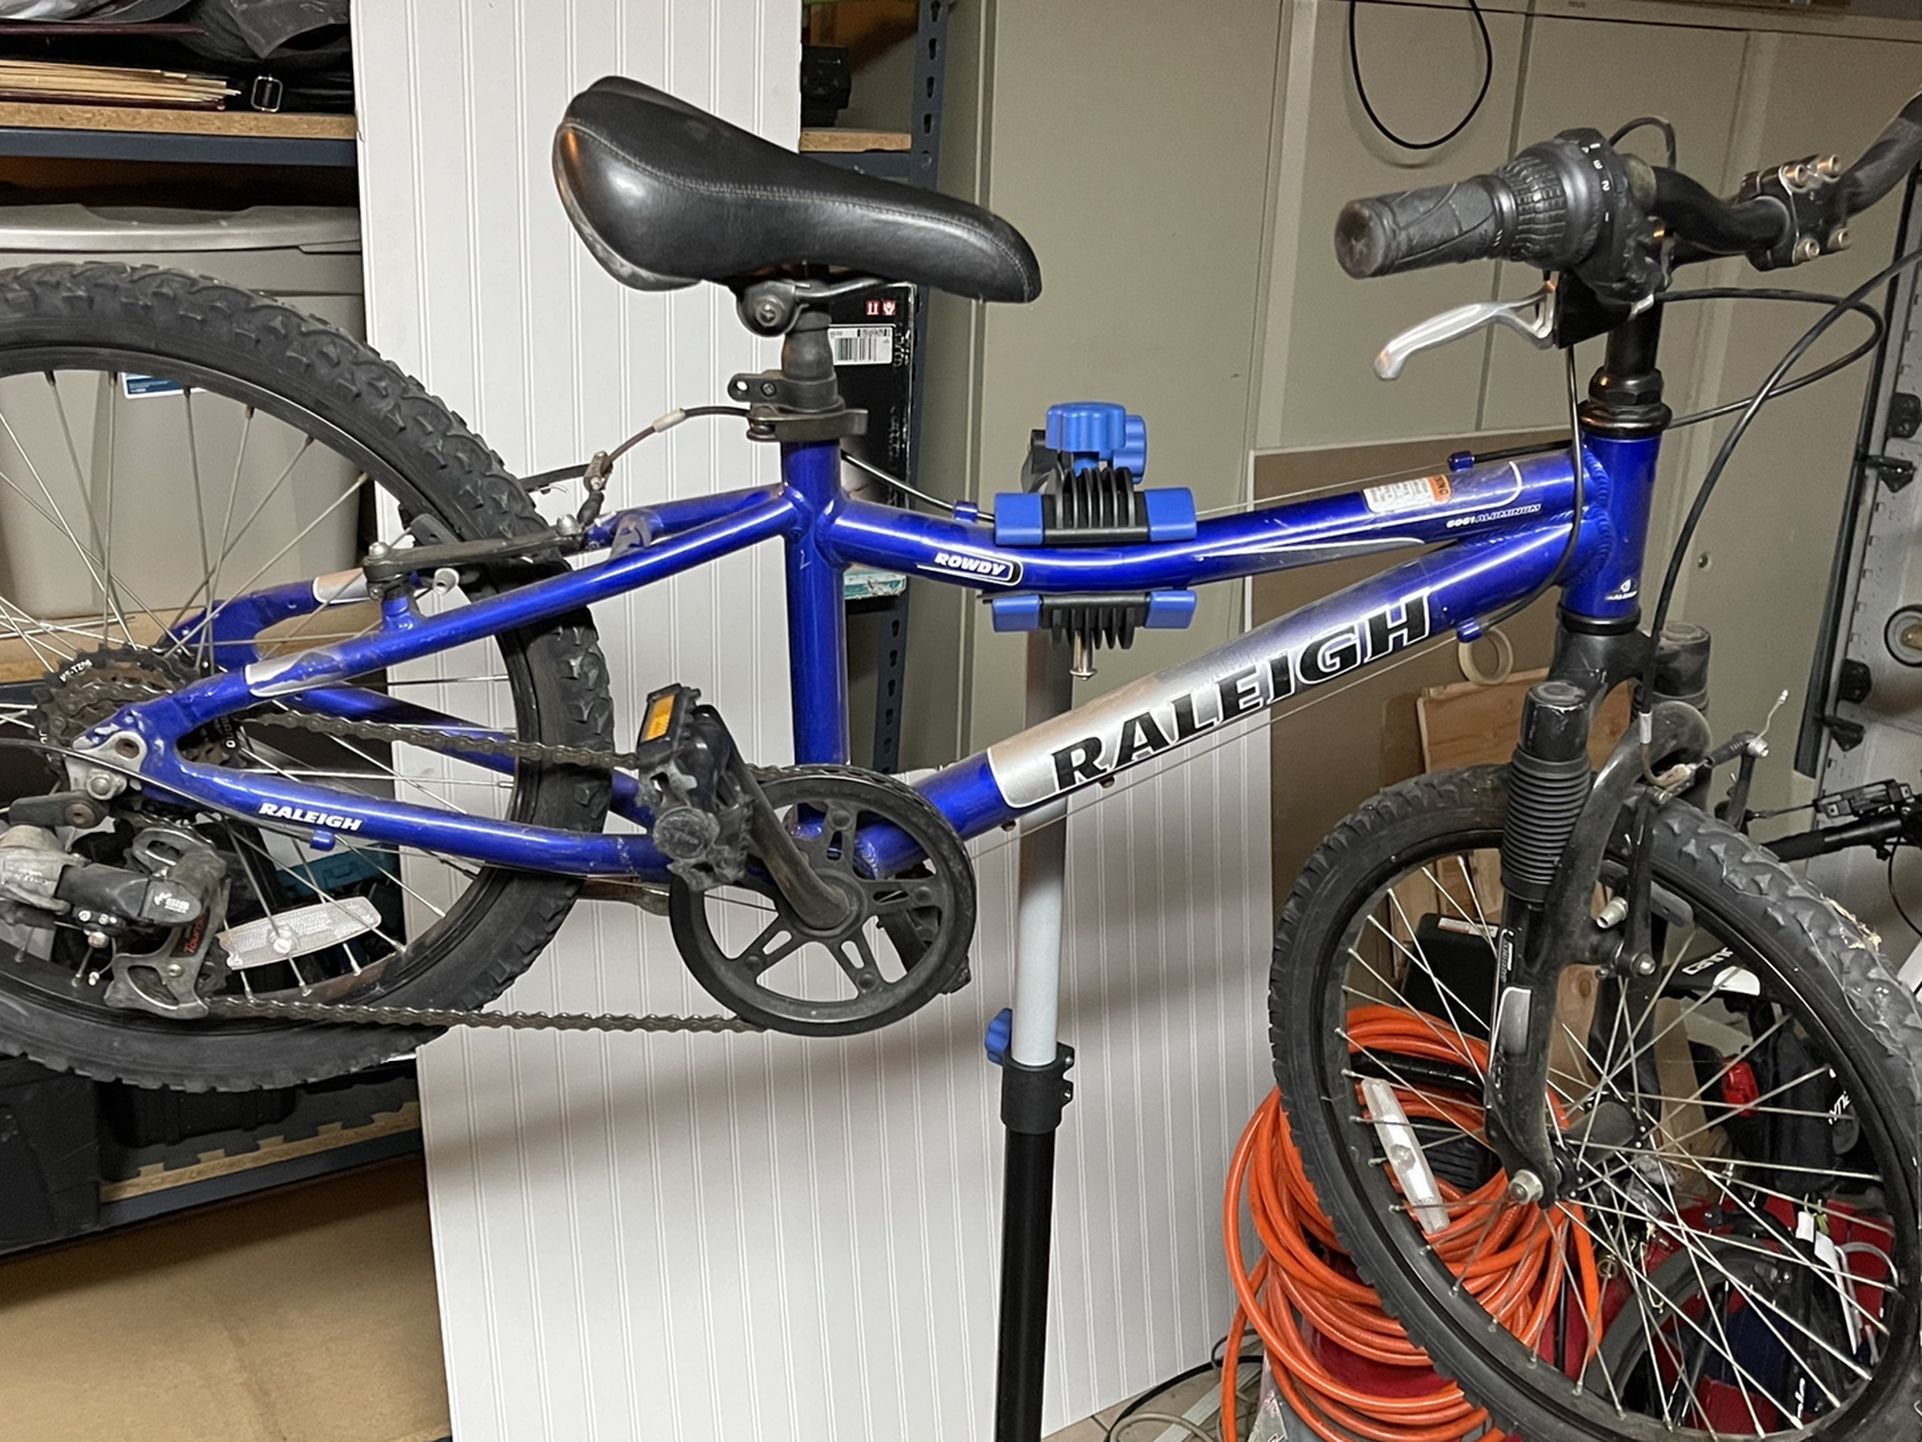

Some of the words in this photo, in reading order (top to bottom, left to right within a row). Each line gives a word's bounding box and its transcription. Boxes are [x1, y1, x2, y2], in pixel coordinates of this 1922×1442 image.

[1601, 179, 1611, 192] 2
[1604, 211, 1610, 223] 1
[1446, 516, 1476, 529] 6061
[934, 552, 1007, 576] ROWDY
[1051, 588, 1431, 792] RALEIGH
[258, 802, 363, 831] RALEIGH
